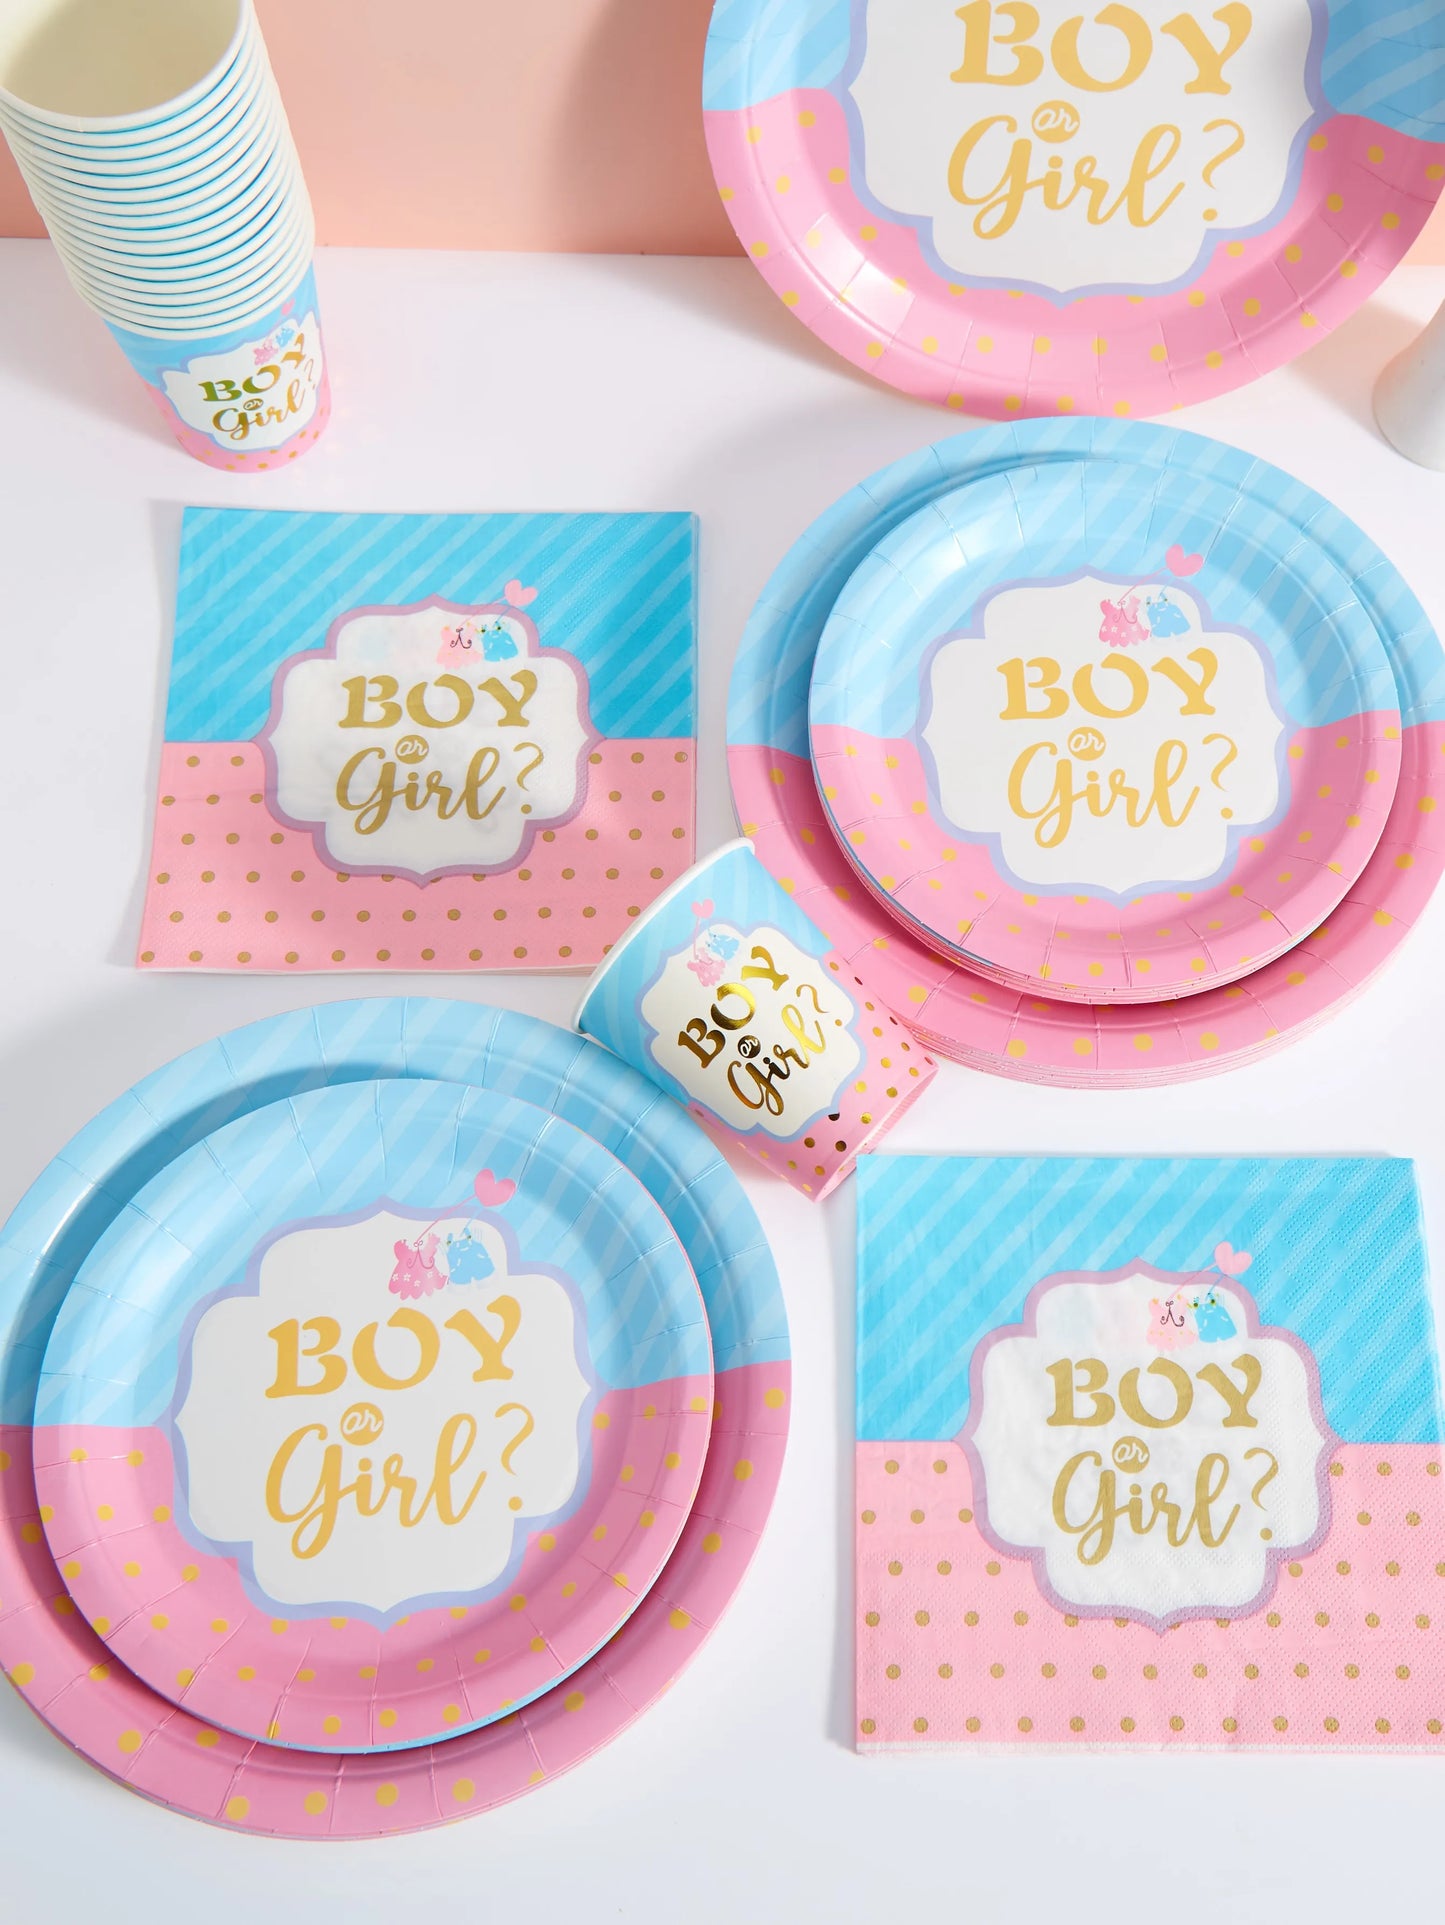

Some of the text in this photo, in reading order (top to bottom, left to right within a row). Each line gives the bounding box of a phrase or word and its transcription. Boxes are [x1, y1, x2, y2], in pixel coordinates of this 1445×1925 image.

[949, 0, 1253, 96] BOY
[947, 114, 1245, 240] Girl?
[197, 332, 306, 403] BOY
[337, 669, 539, 729] BOY
[996, 647, 1219, 721] BOY
[335, 741, 545, 836] Girl?
[1007, 732, 1239, 849] Girl?
[677, 945, 790, 1069] BOY
[727, 983, 843, 1117] Girl?
[264, 1294, 522, 1399] BOY
[1045, 1353, 1263, 1429] BOY
[265, 1402, 535, 1560] Girl?
[1051, 1447, 1280, 1566] Girl?
